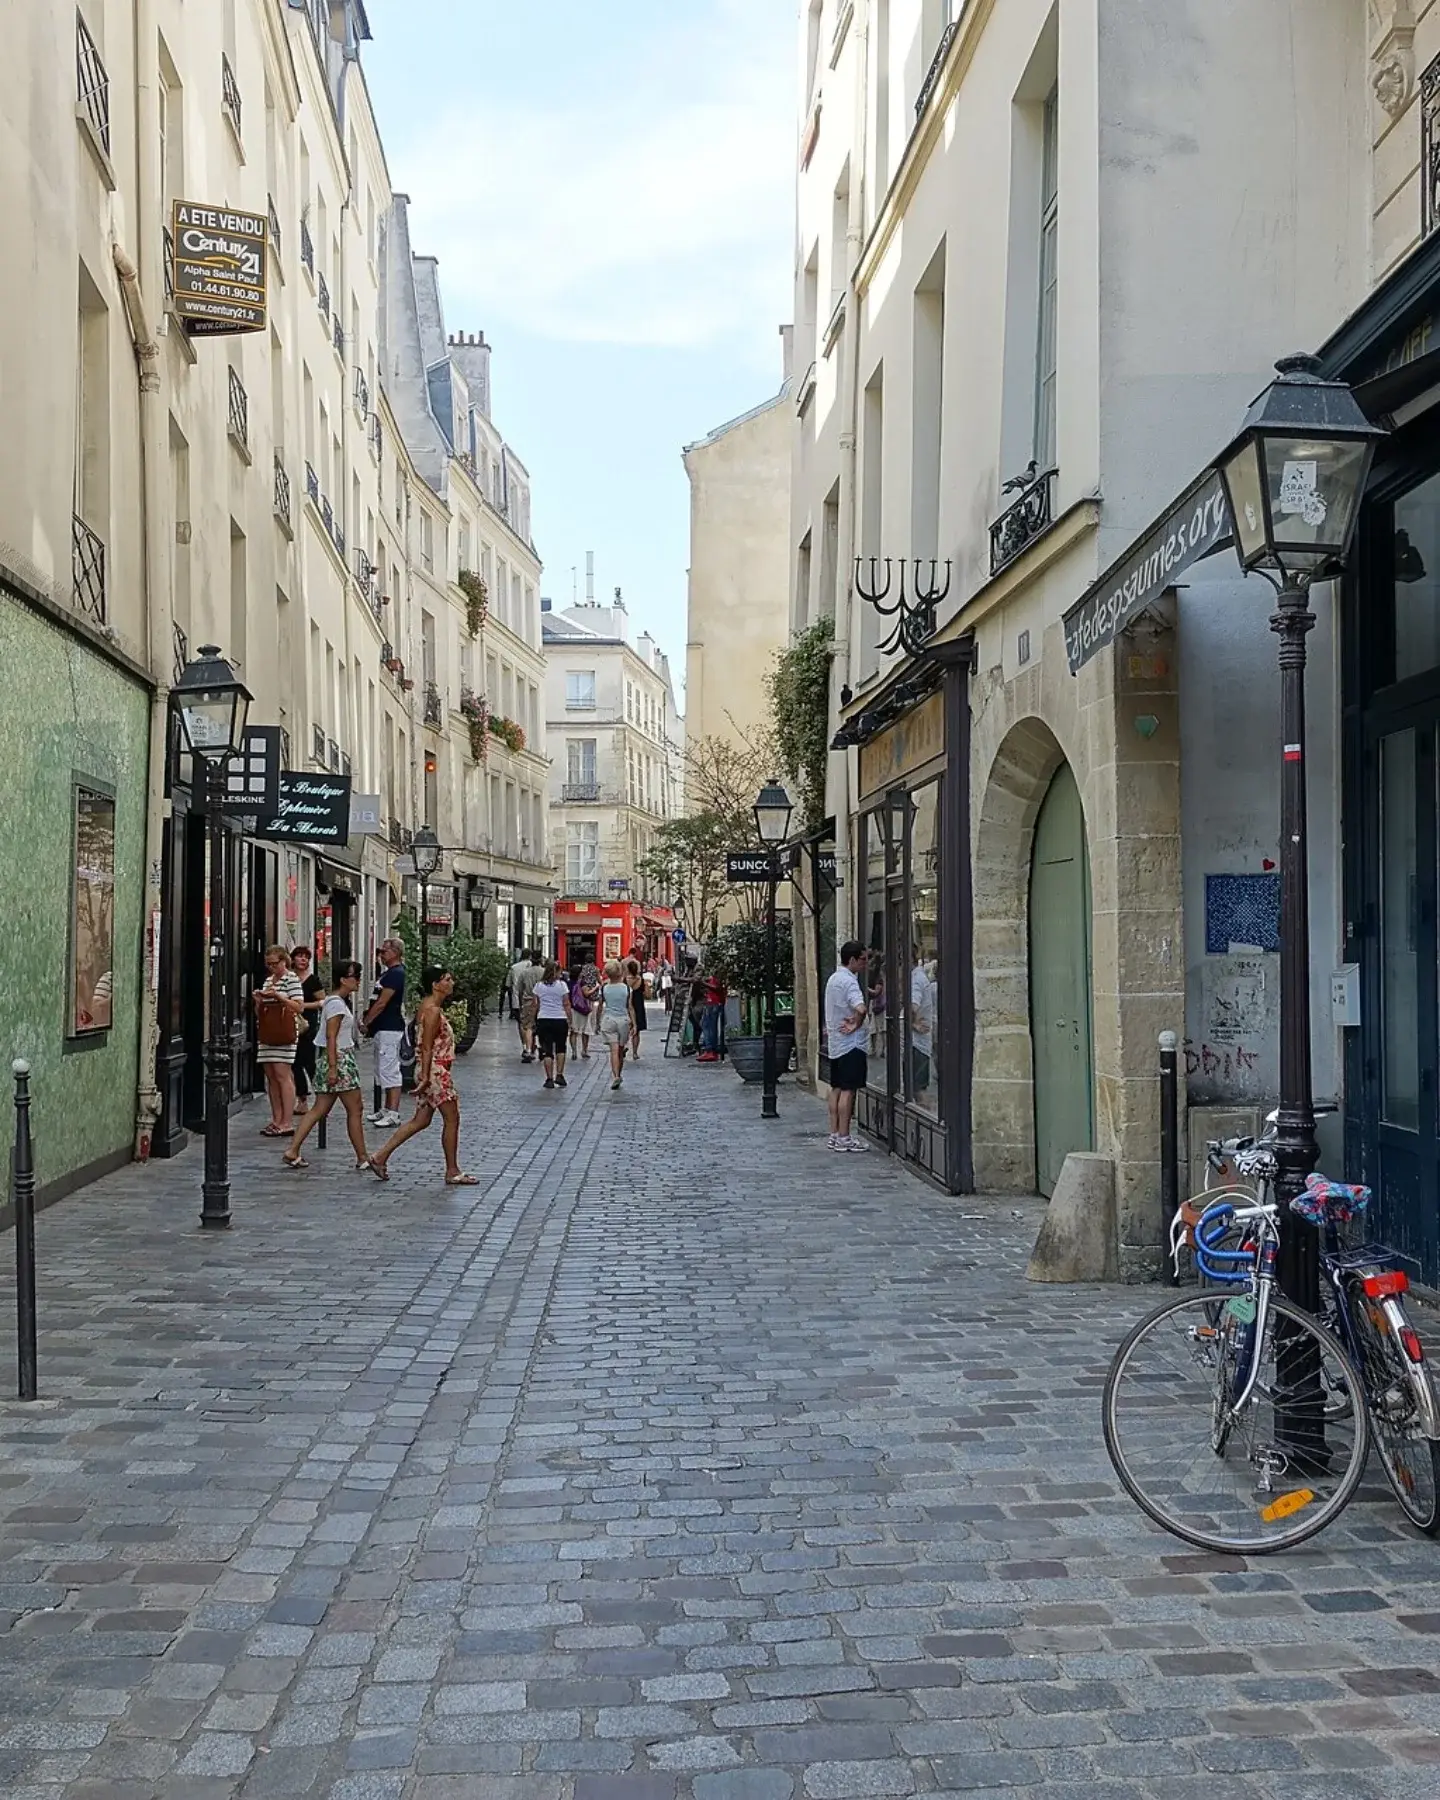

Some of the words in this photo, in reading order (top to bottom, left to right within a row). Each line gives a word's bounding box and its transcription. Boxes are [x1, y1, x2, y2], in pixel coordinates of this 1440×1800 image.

[178, 207, 189, 223] A
[191, 208, 216, 227] ETE
[219, 213, 263, 236] VENDU
[183, 230, 248, 258] Century
[184, 265, 211, 277] Alpha
[212, 268, 236, 280] Saint
[237, 273, 257, 284] Paul
[185, 301, 256, 320] www.century21.fr
[206, 795, 265, 804] MLESKINE
[292, 821, 339, 836] Marais
